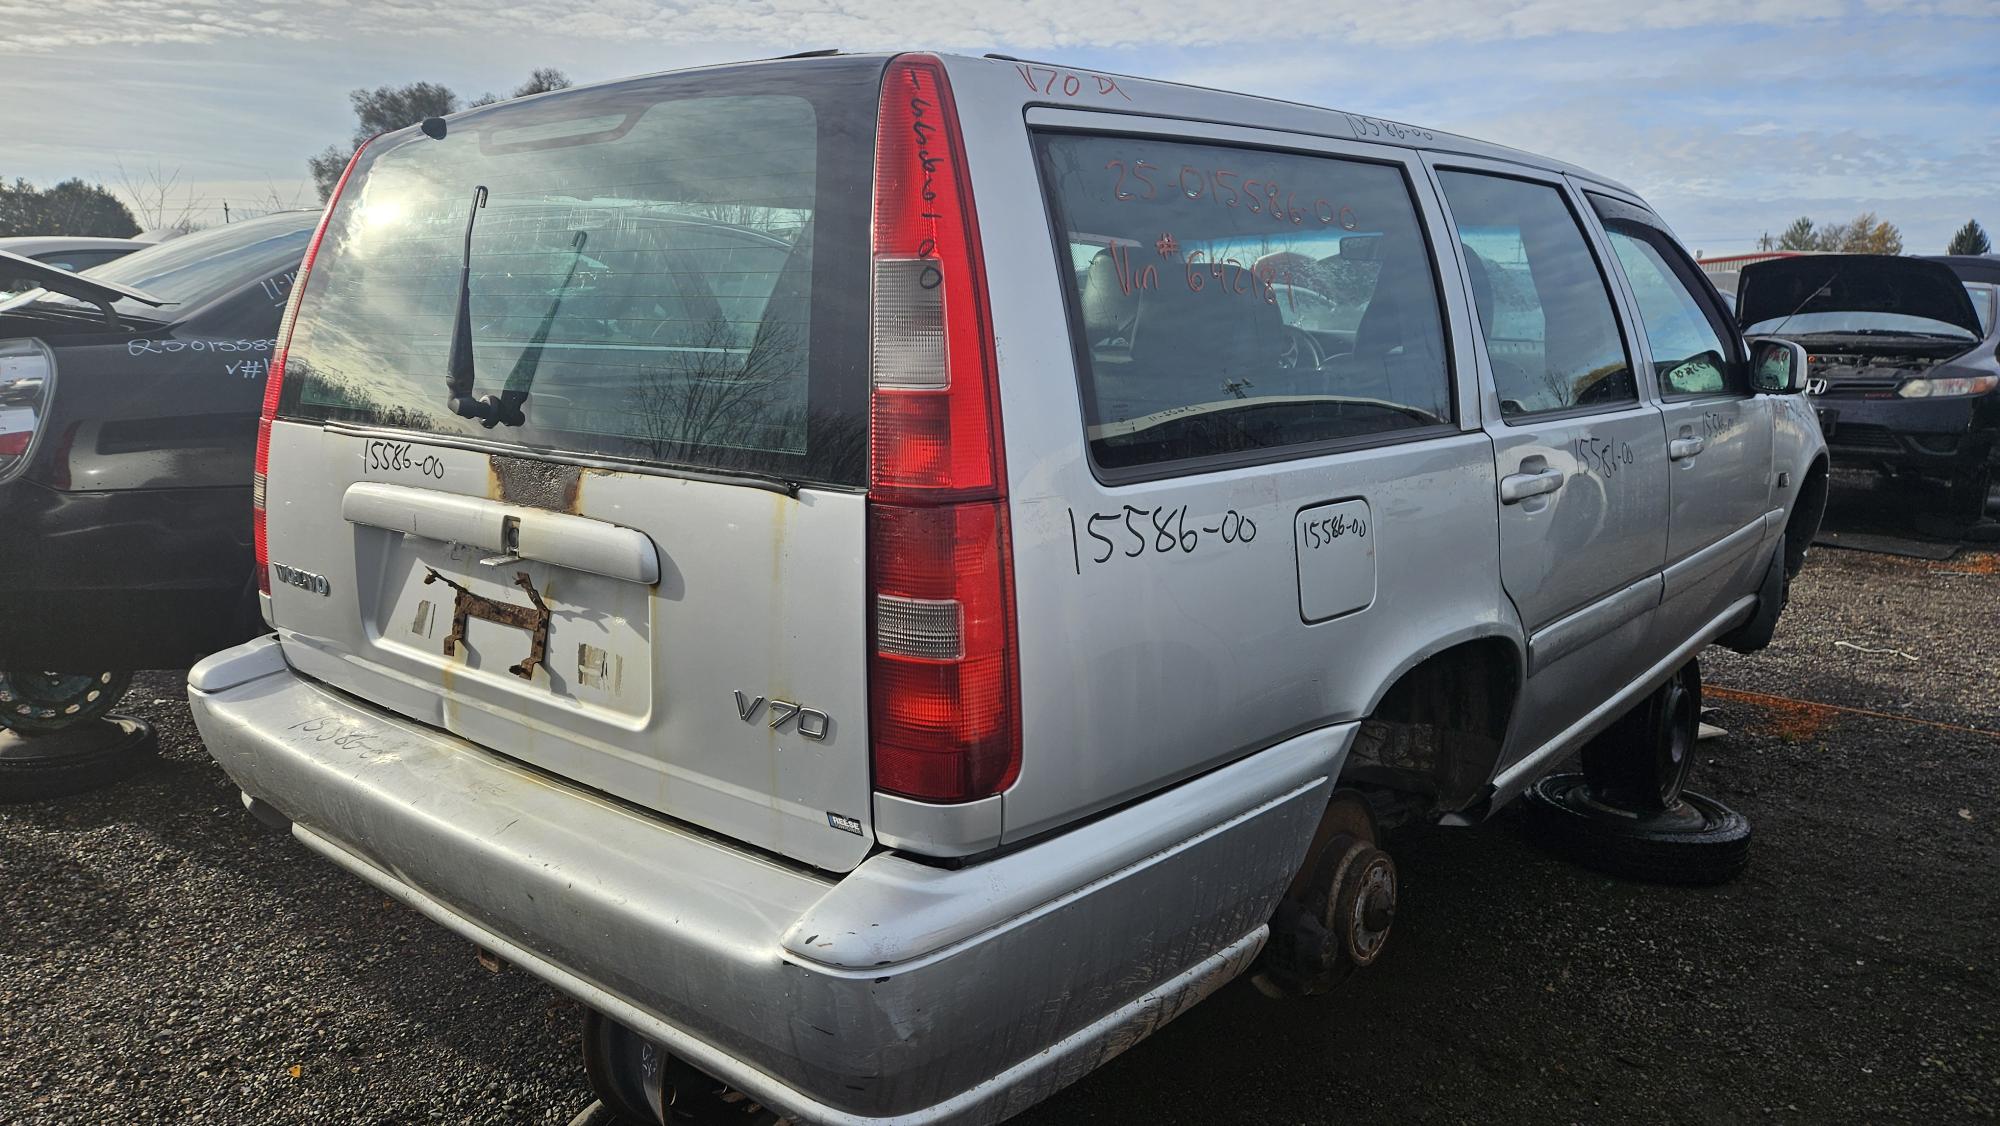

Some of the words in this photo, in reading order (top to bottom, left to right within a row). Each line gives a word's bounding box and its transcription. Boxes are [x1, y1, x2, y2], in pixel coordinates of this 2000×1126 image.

[363, 438, 446, 480] 15586-00
[1067, 503, 1257, 576] 15586-00
[1303, 513, 1367, 549] 15586-00
[733, 688, 830, 742] V70
